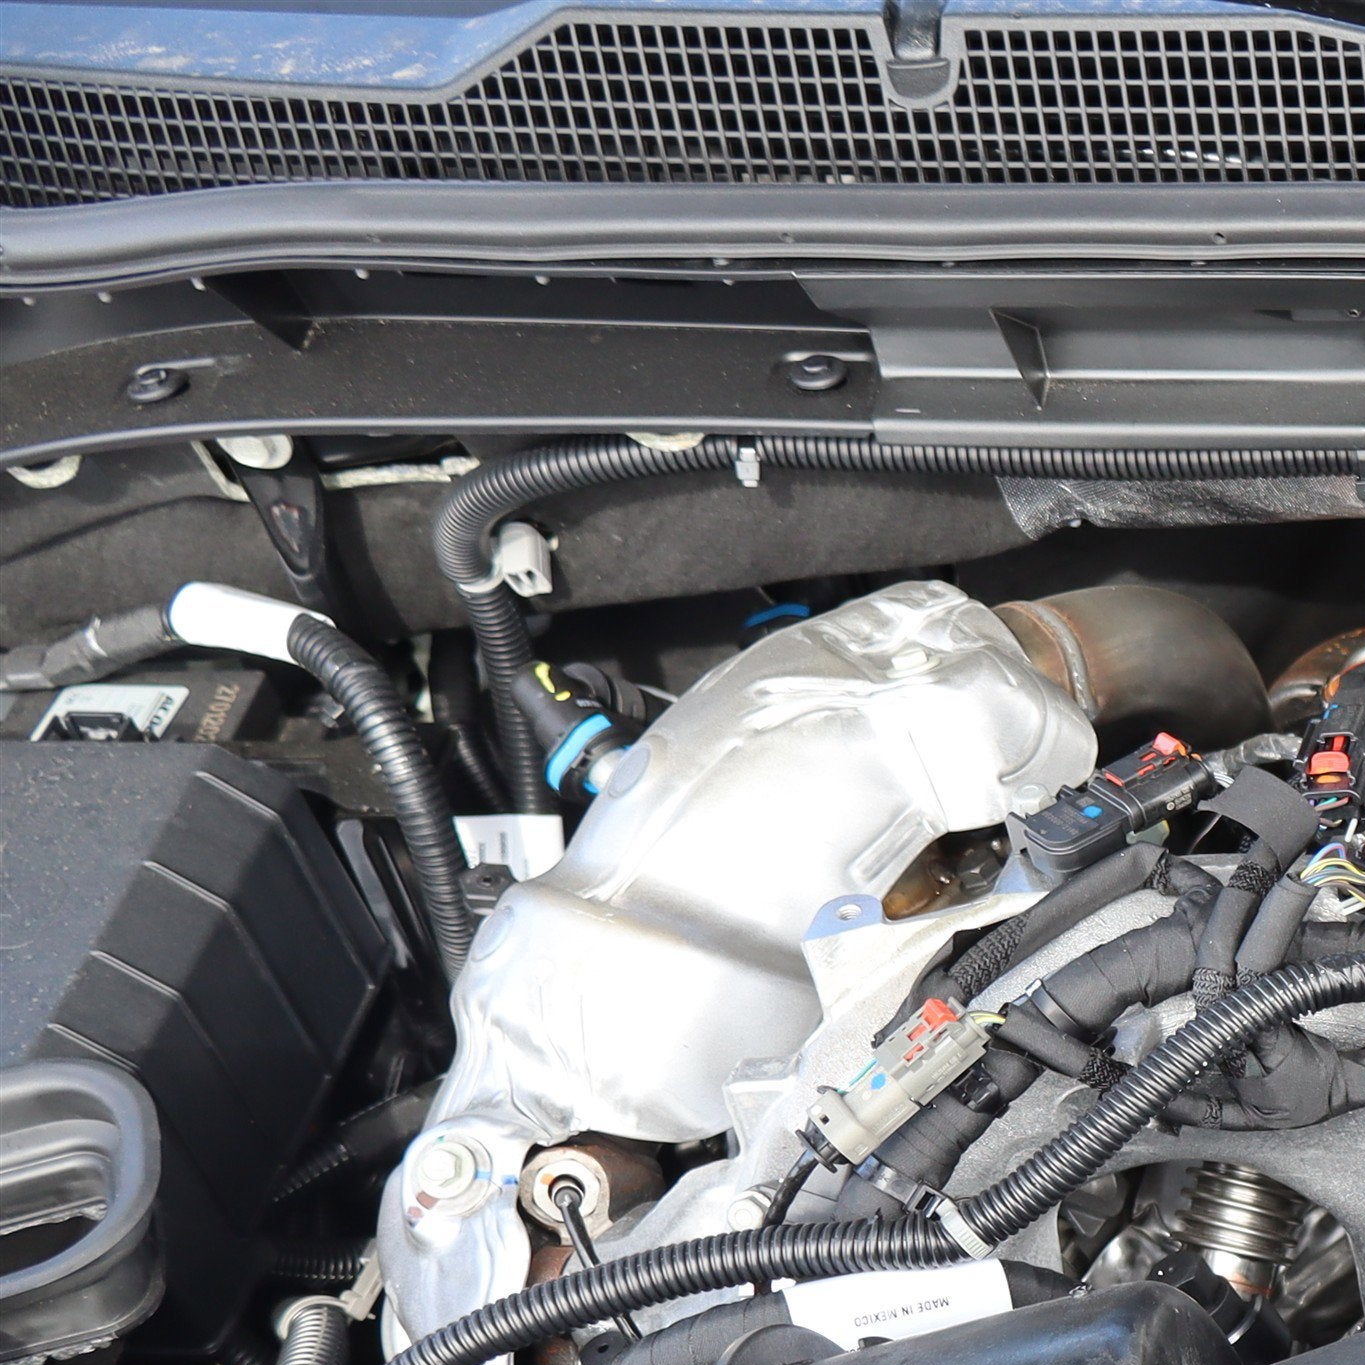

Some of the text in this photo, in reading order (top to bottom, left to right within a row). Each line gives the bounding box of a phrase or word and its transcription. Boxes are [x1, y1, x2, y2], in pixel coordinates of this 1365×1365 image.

[854, 1296, 950, 1328] MADE IN MEXICO
